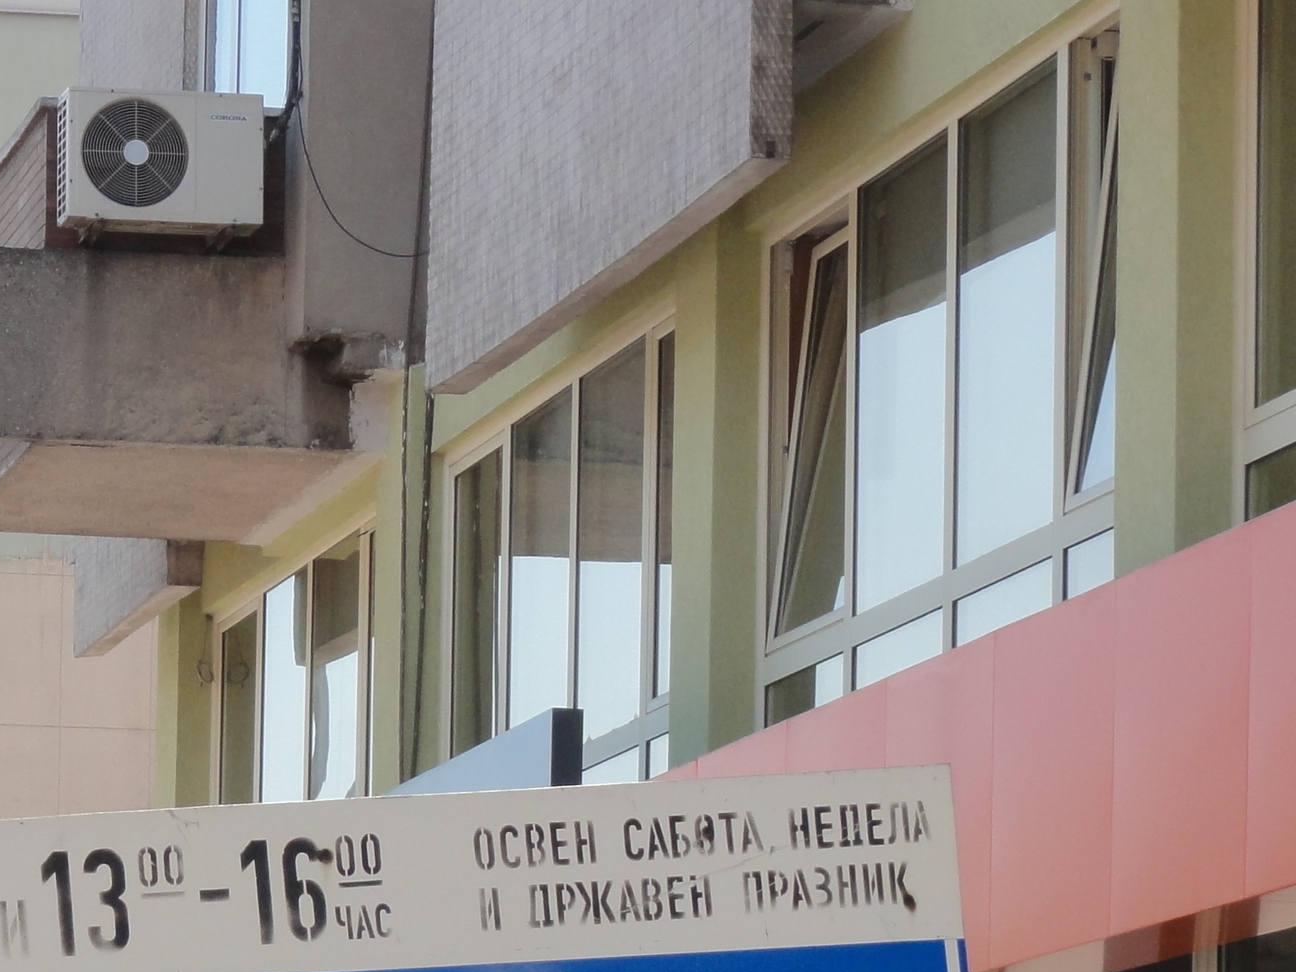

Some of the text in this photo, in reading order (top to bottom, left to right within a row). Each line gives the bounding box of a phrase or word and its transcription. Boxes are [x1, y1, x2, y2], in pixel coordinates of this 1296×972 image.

[473, 819, 597, 871] ОСВЕН
[788, 799, 932, 850] НЕДЕЛА
[334, 902, 392, 941] ЧАС
[478, 860, 917, 931] И ДРЖАВЕН ПРАЗНИК
